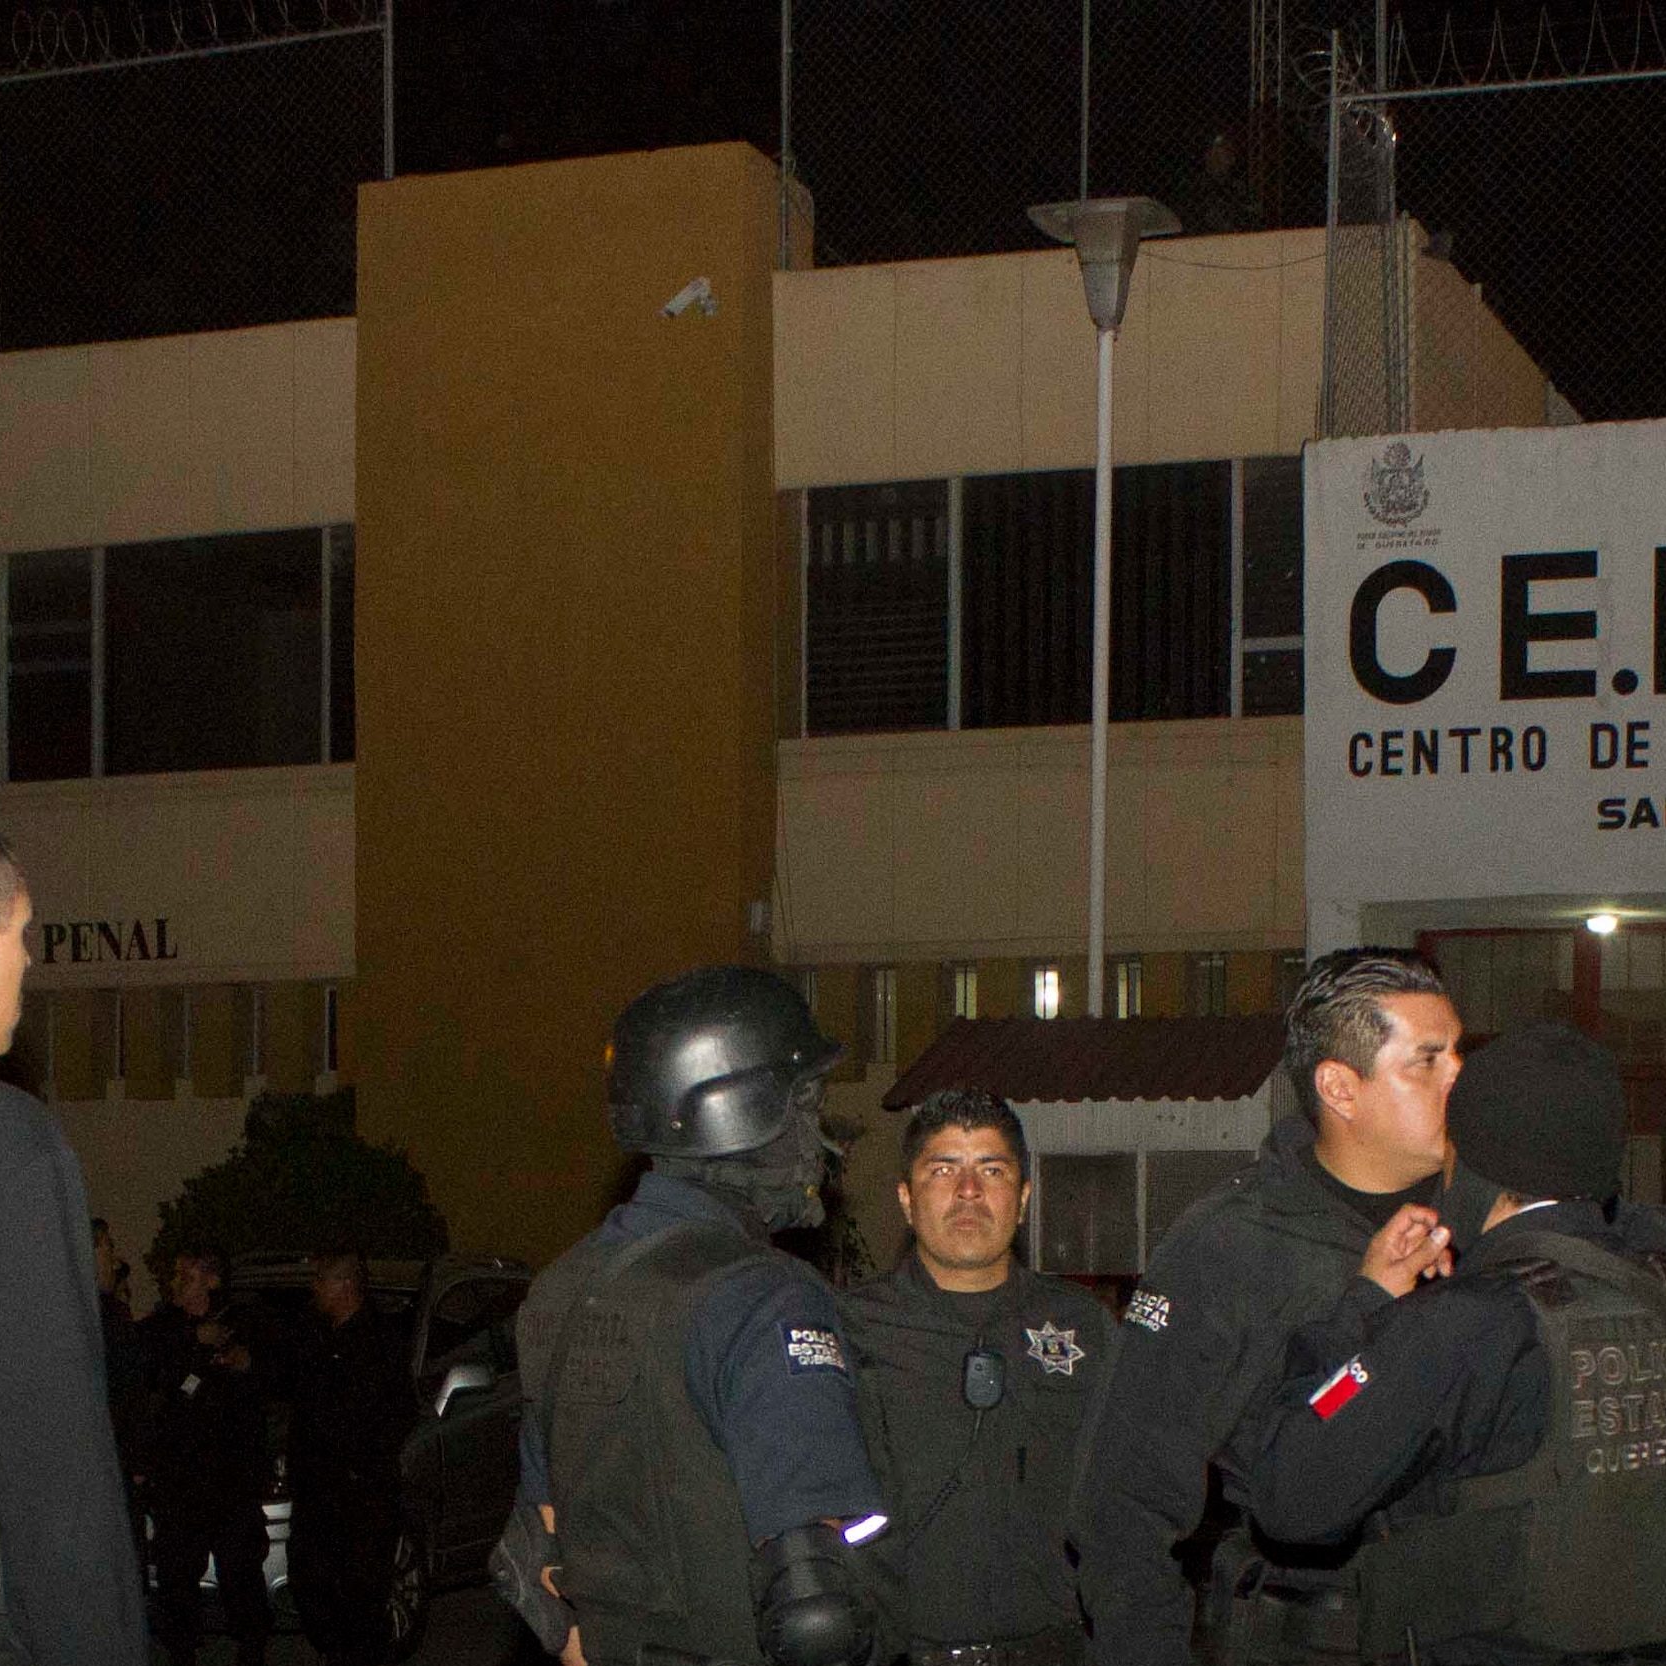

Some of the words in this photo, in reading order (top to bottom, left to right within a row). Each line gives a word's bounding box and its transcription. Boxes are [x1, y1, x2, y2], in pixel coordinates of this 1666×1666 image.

[1349, 726, 1548, 777] CENTRO
[1590, 721, 1651, 769] DE
[41, 917, 179, 965] PENAL
